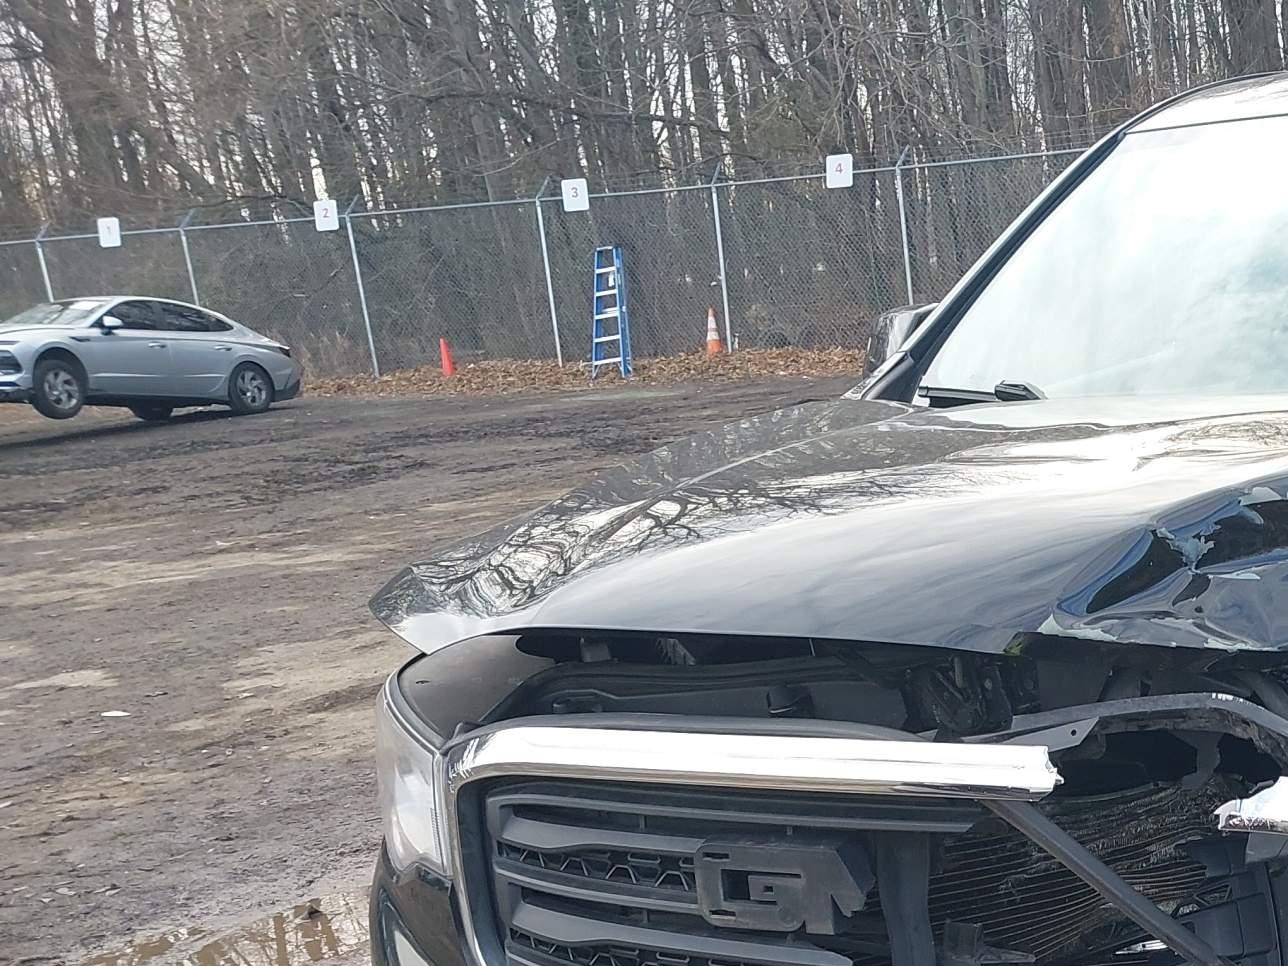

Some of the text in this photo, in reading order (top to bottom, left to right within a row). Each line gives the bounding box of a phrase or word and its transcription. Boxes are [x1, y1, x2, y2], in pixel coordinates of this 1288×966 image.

[835, 163, 844, 175] 4
[570, 187, 579, 198] 3
[322, 208, 330, 218] 2
